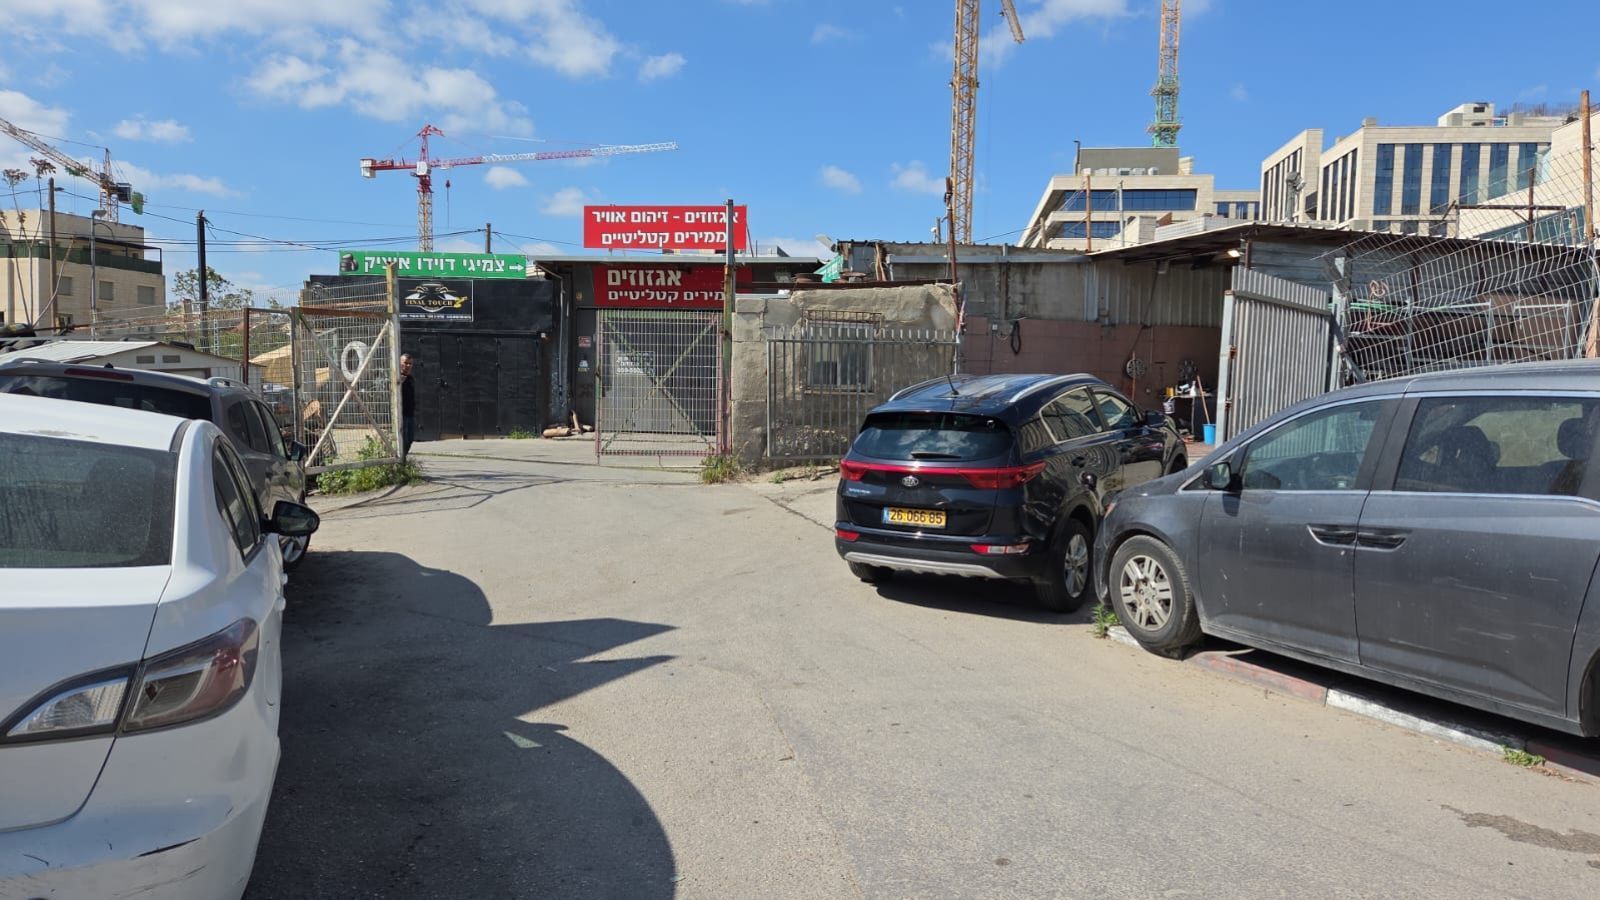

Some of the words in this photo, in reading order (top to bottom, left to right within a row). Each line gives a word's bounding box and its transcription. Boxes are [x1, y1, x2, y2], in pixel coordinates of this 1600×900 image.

[592, 211, 626, 223] אוויר
[631, 211, 669, 223] זיהום
[684, 211, 739, 223] אגזוזים
[602, 229, 670, 248] קטליטיים
[364, 256, 410, 273] איציק
[417, 257, 456, 271] דוידו
[462, 258, 505, 271] צמיגי
[607, 269, 682, 286] אגזוזים
[608, 288, 679, 303] קטליטיים
[683, 290, 728, 301] מירים
